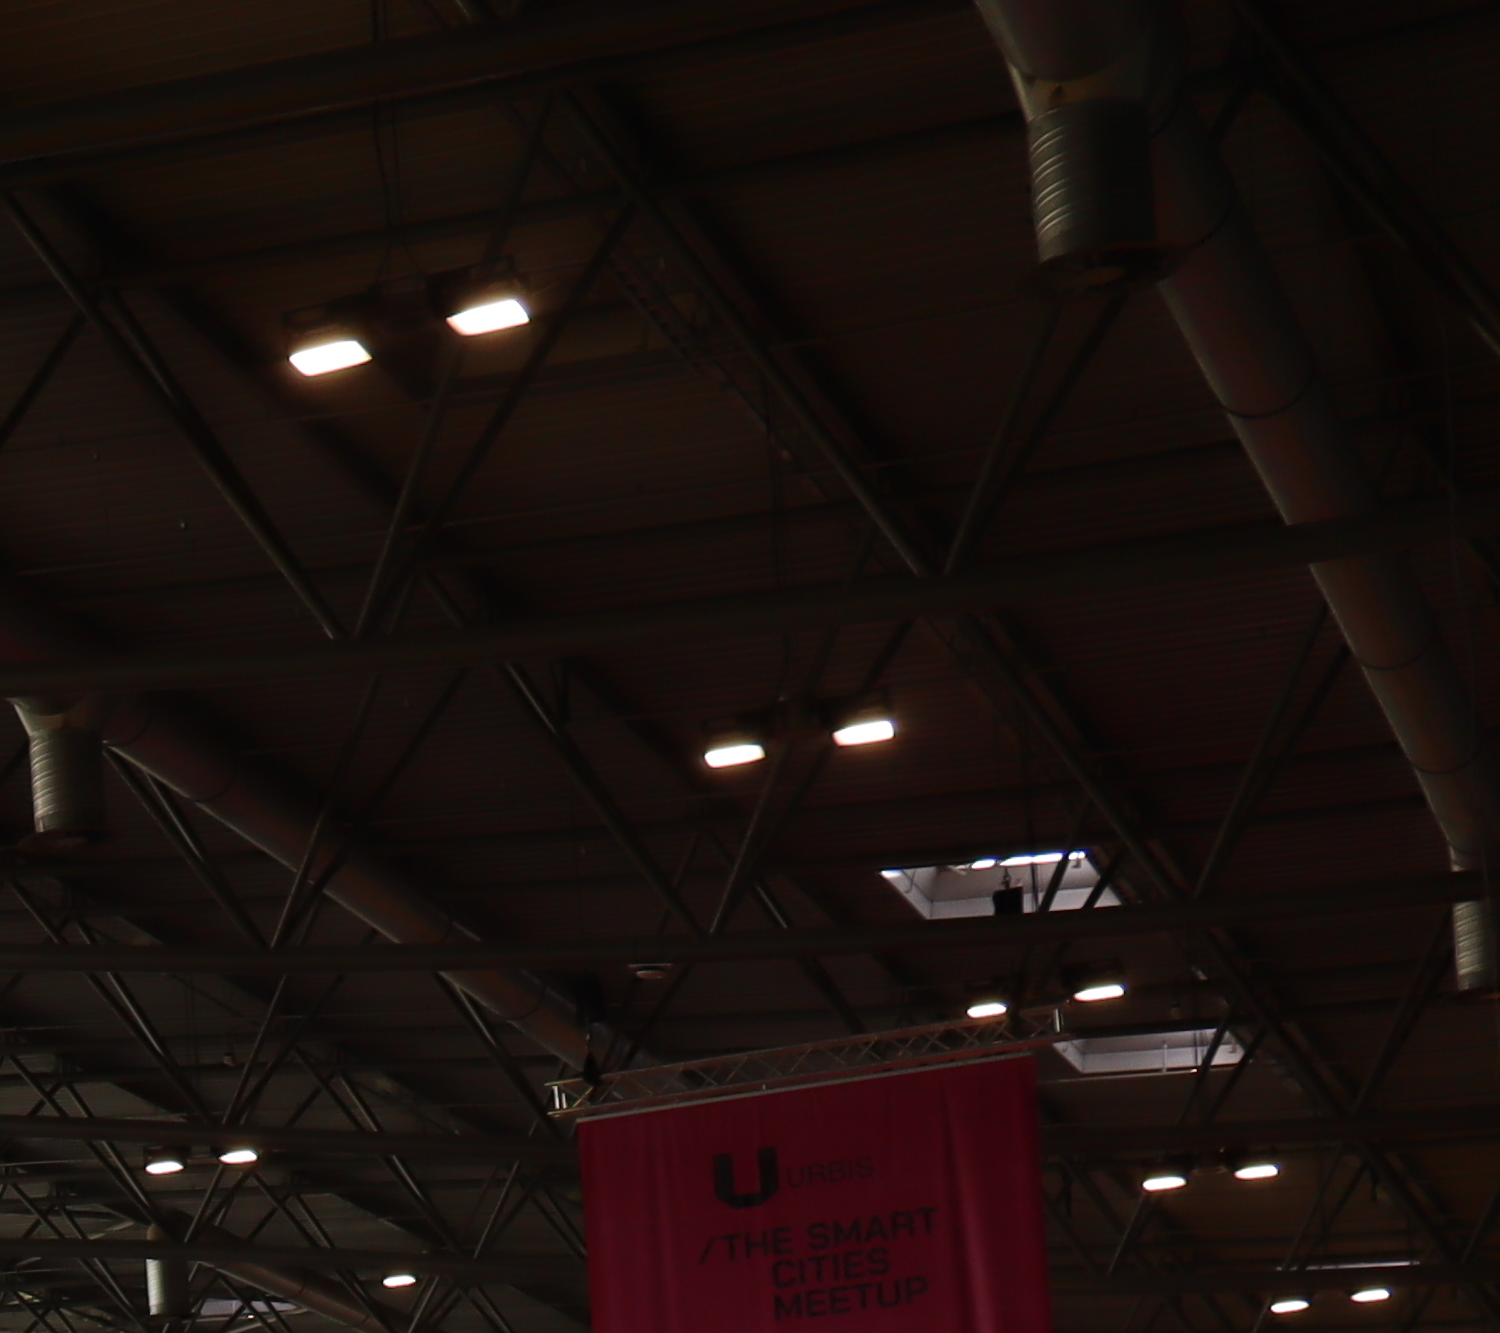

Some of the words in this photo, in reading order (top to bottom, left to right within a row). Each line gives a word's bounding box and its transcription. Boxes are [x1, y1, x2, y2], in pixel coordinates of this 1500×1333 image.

[787, 1157, 874, 1189] URBIS
[808, 1208, 937, 1250] SMART
[773, 1247, 890, 1288] CITIES
[775, 1275, 929, 1320] MEETUP
